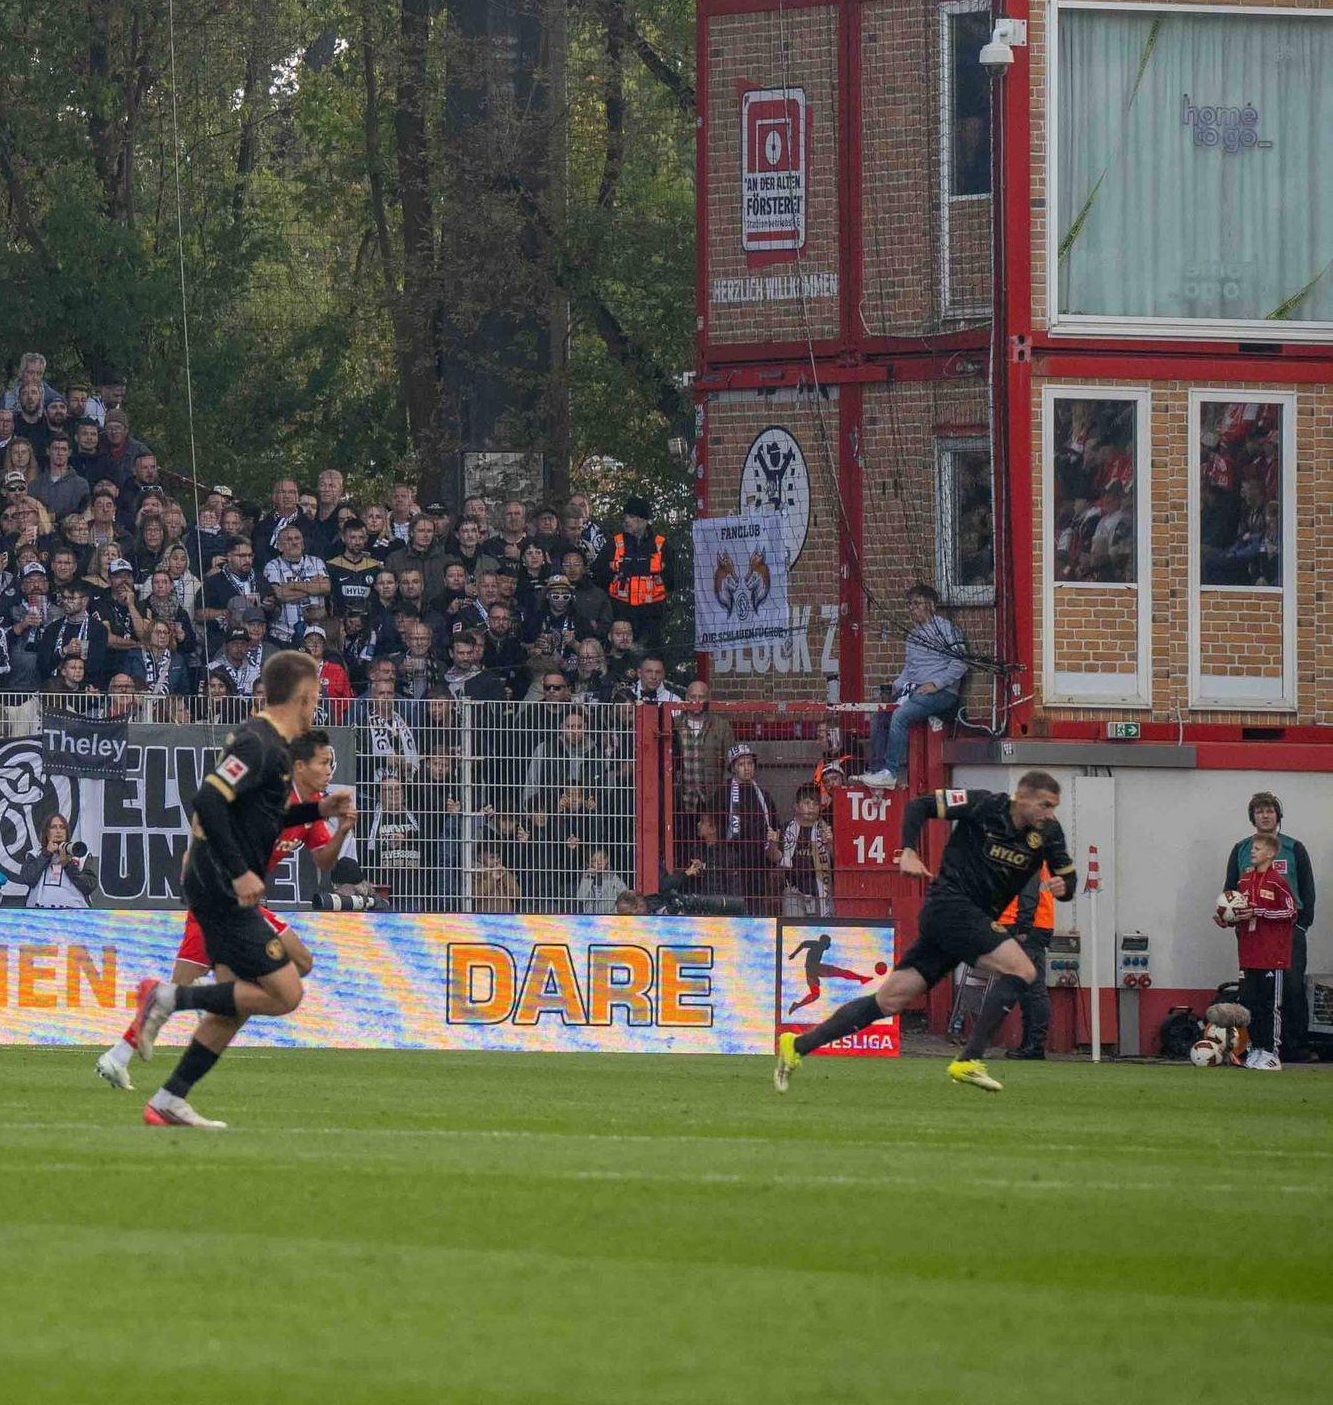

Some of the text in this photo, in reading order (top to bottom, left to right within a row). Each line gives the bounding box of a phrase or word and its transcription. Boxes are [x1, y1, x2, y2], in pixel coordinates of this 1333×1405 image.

[760, 176, 775, 191] DER
[776, 174, 800, 190] ALTEN
[713, 273, 838, 302] HERZLICH WILLKMMEN
[720, 524, 762, 540] FANCLUB
[44, 729, 126, 762] Theley
[847, 792, 891, 821] Tor
[853, 835, 886, 864] 14
[447, 943, 713, 1027] DARE
